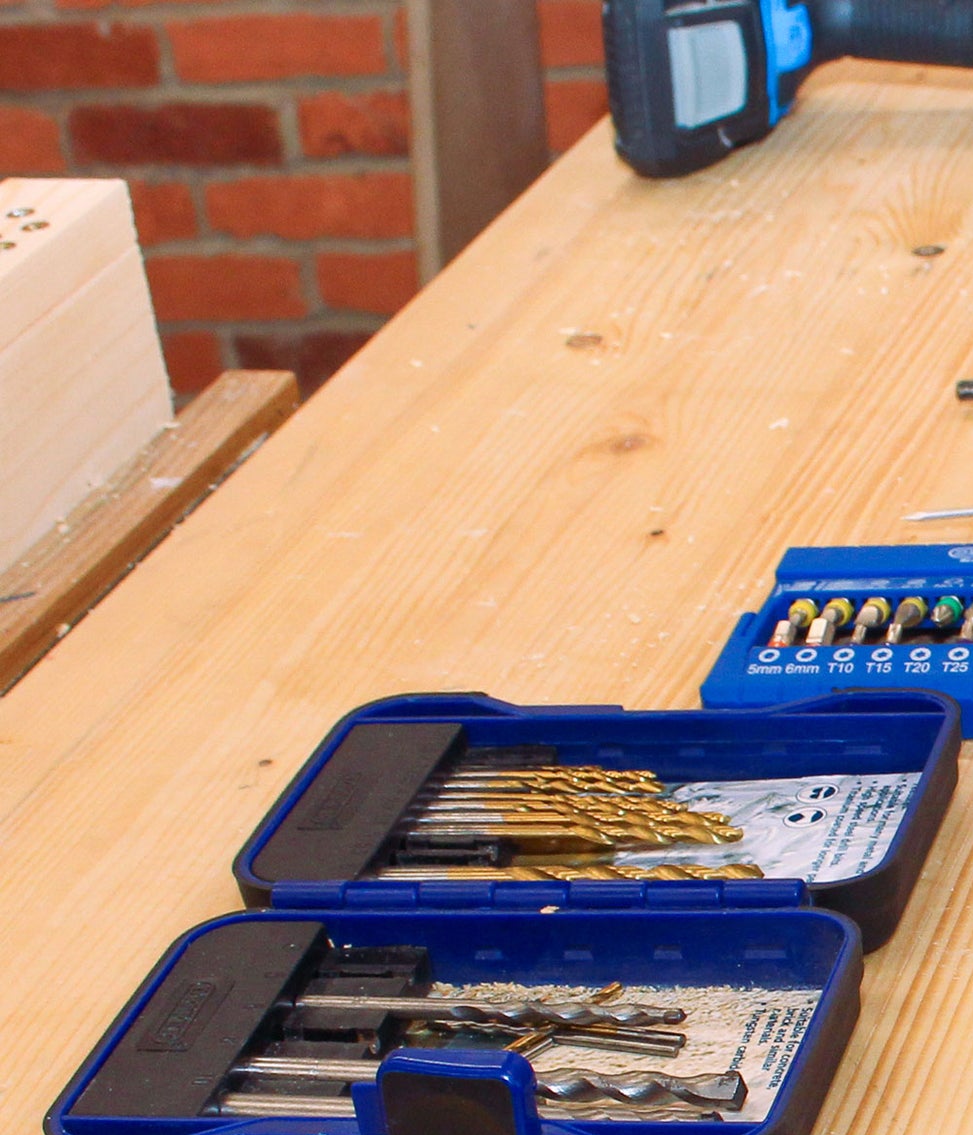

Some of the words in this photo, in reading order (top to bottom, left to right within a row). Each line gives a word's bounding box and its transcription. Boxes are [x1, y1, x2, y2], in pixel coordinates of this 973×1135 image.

[747, 664, 782, 675] 5mm
[784, 663, 820, 674] 6mm
[828, 662, 854, 673] T10
[866, 662, 892, 673] T15
[904, 662, 930, 673] T20
[942, 661, 969, 673] T25
[741, 1008, 767, 1043] Tungsten
[783, 1008, 799, 1026] brick
[791, 1007, 813, 1038] Suitable
[773, 1028, 787, 1043] and
[784, 1039, 801, 1052] for
[729, 1046, 747, 1071] carbid
[767, 1054, 791, 1090] concrete,
